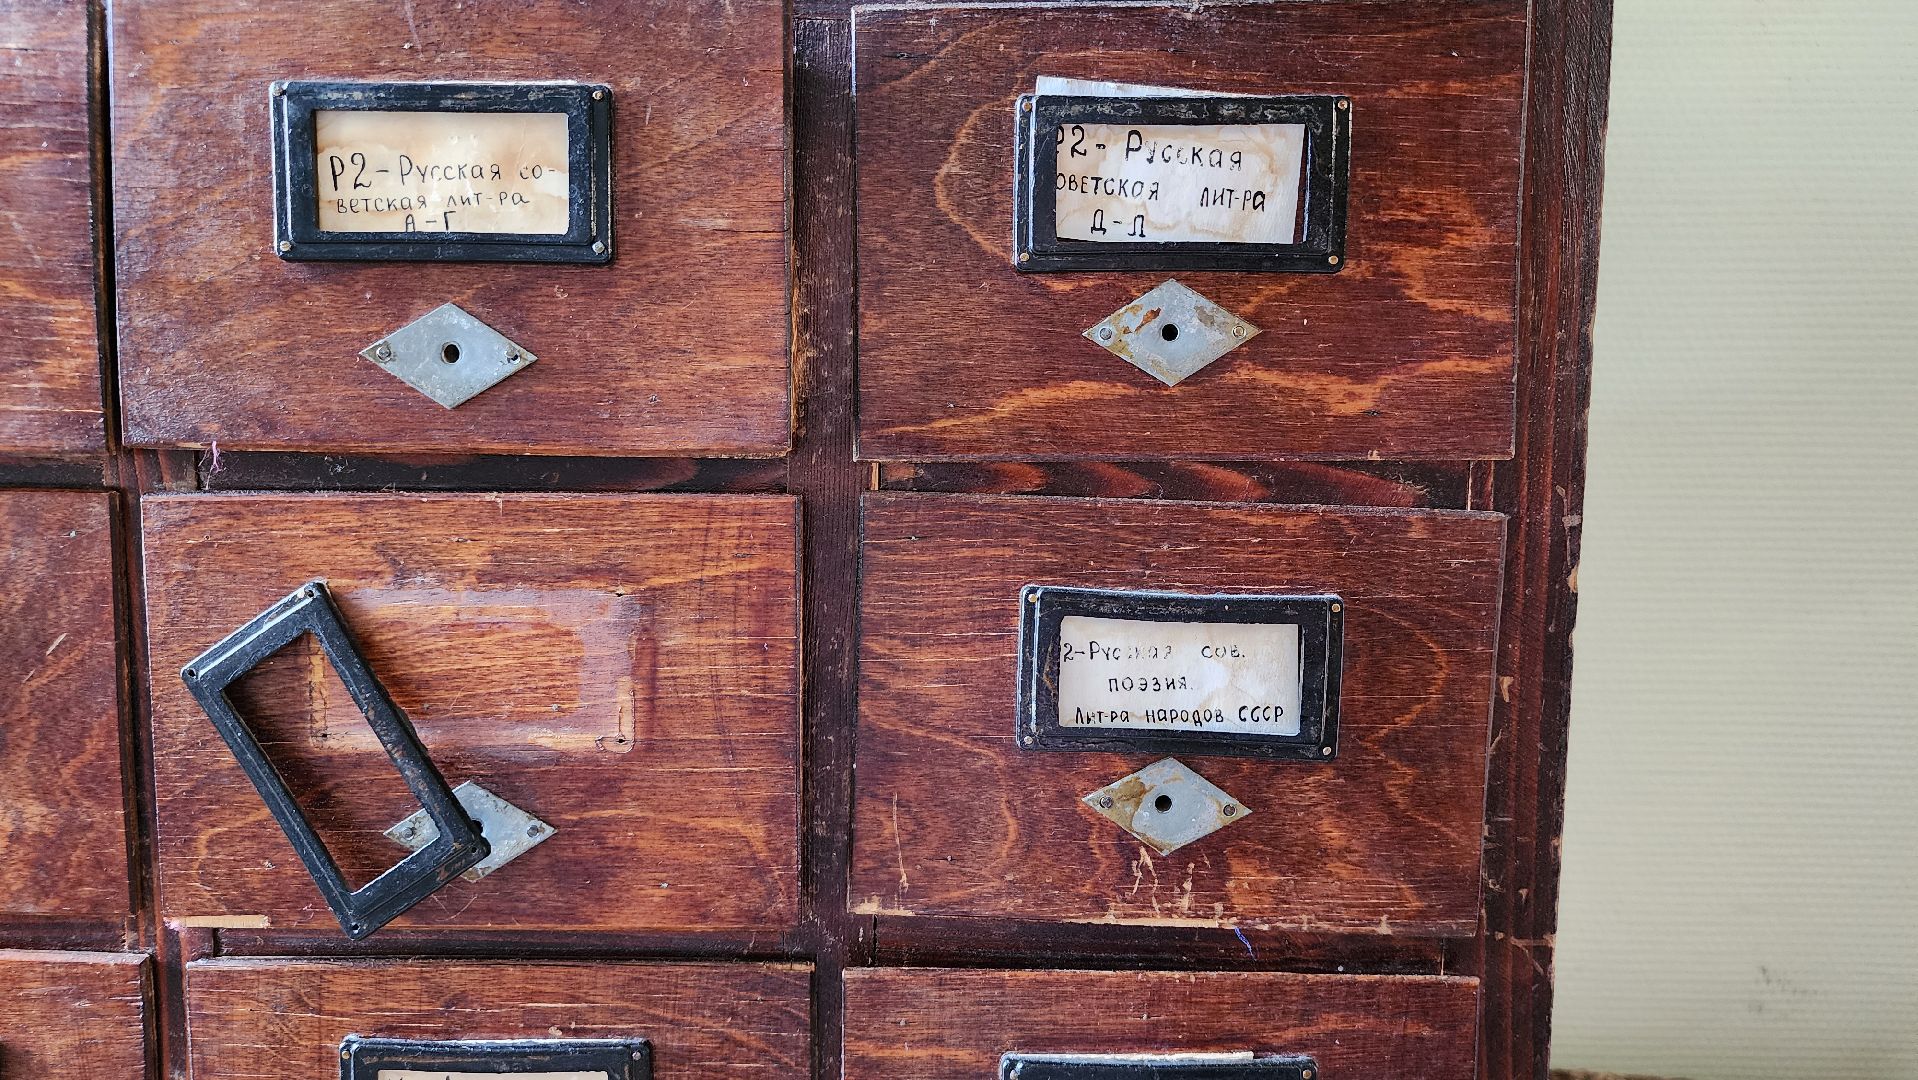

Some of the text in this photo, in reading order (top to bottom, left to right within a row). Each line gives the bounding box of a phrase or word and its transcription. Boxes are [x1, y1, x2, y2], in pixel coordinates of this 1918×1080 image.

[336, 193, 428, 214] ветская
[1145, 708, 1225, 727] народов
[1238, 704, 1285, 724] СССР
